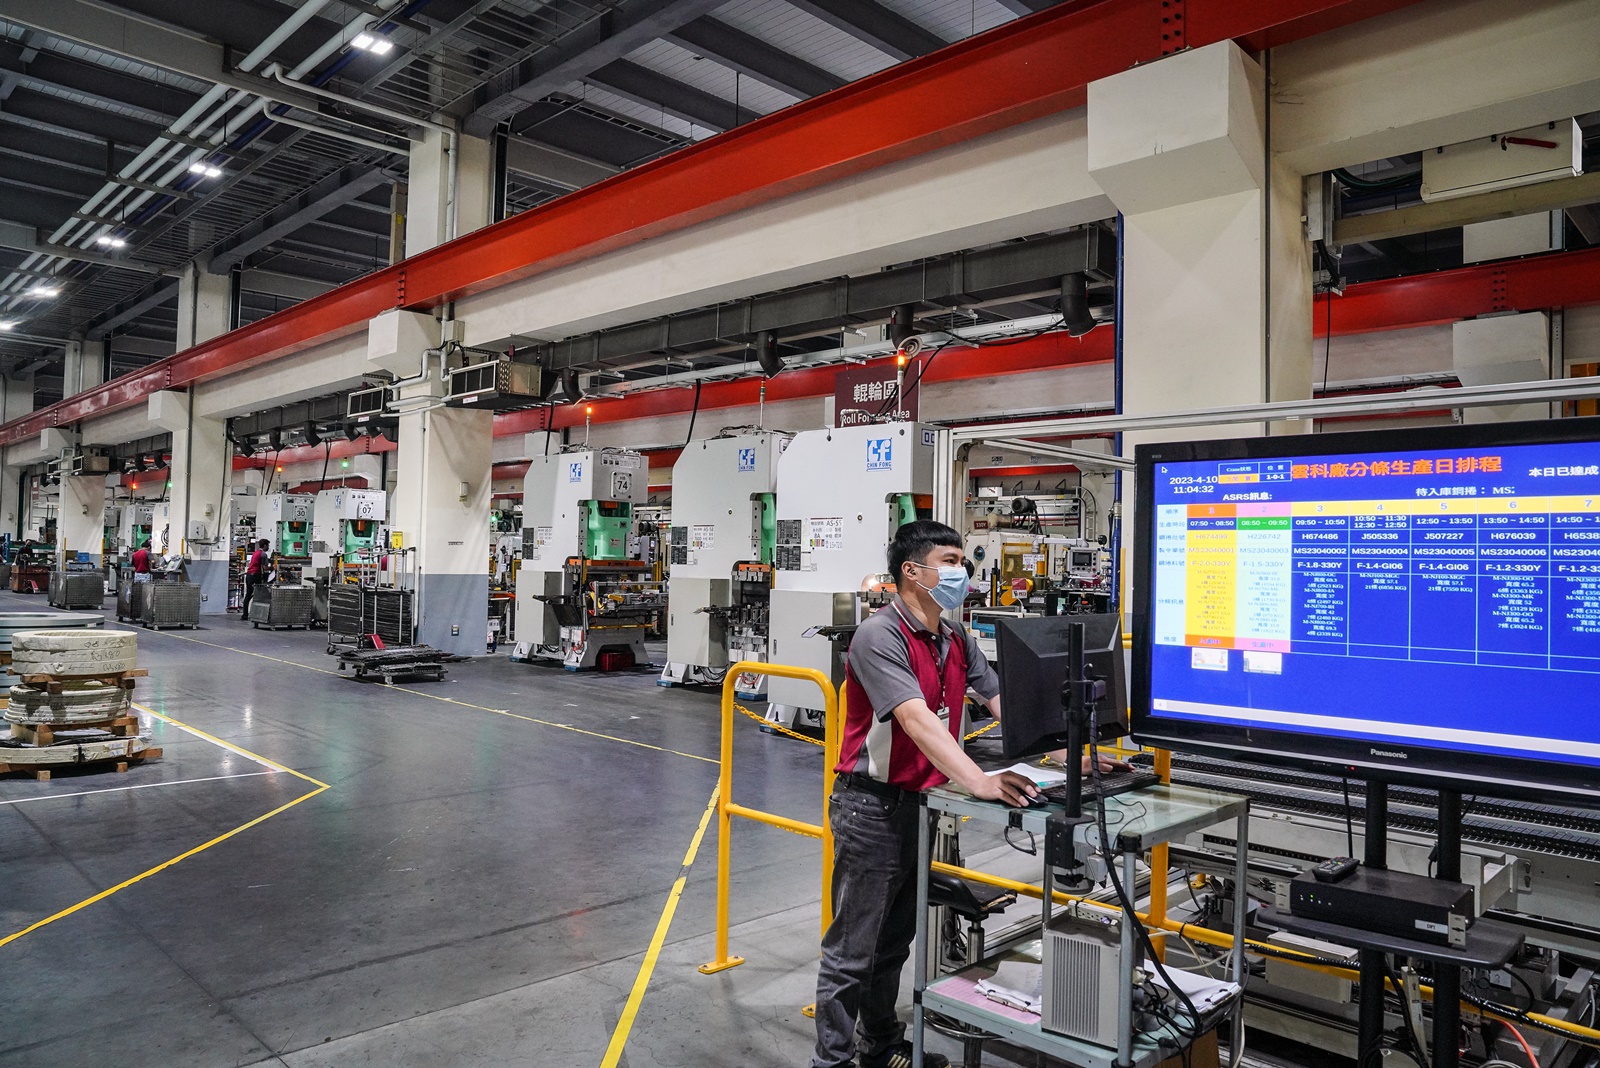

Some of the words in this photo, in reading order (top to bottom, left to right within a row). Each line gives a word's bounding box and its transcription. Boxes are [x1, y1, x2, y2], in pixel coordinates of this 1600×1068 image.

[842, 413, 856, 424] Roll
[892, 410, 910, 419] Aea
[1528, 465, 1599, 478] 本日已達成
[618, 480, 628, 490] 74
[1170, 476, 1218, 485] 2023-4-10
[1174, 486, 1214, 494] 11:04:32
[1370, 748, 1408, 759] Panasonic
